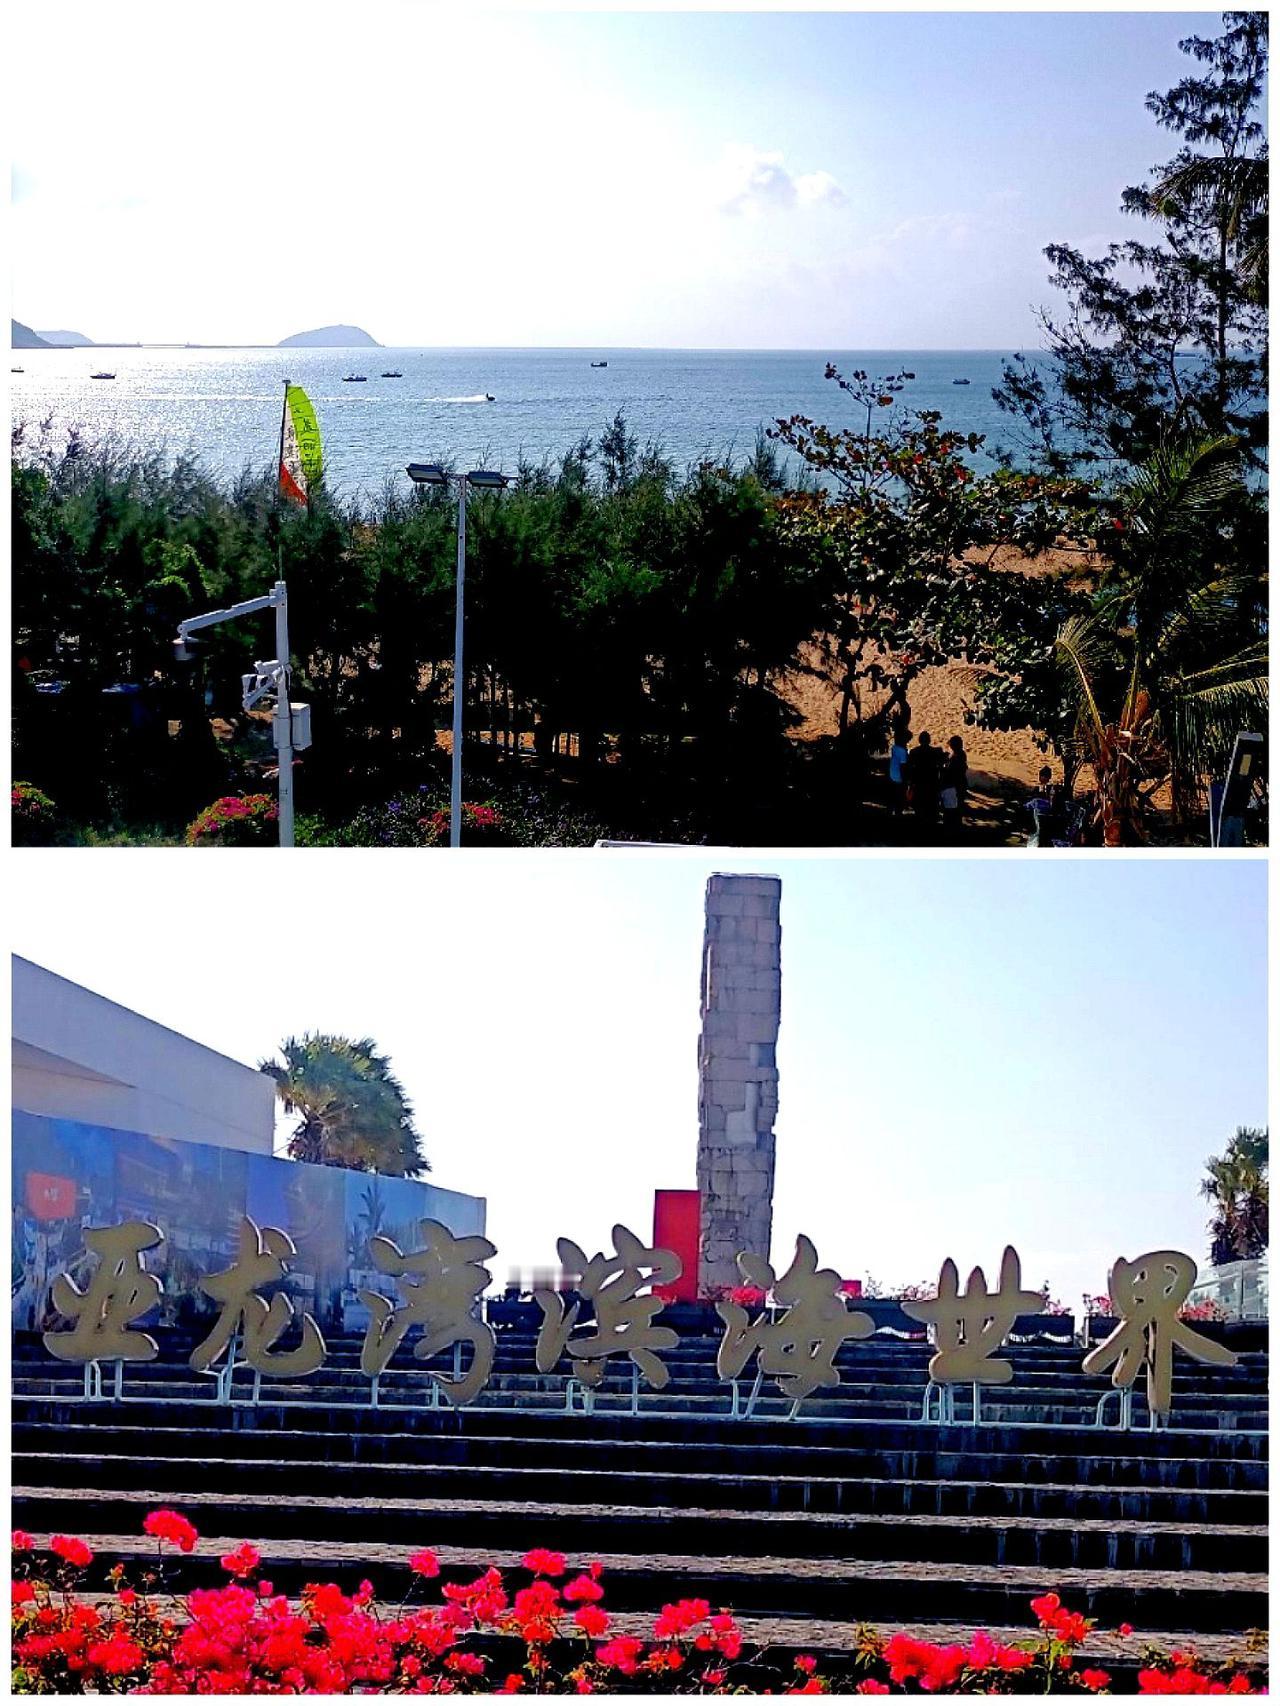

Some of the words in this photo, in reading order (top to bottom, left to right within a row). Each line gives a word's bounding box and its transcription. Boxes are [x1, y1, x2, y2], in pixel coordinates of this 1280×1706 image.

[43, 1216, 1238, 1413] 亚龙湾滨海世界
